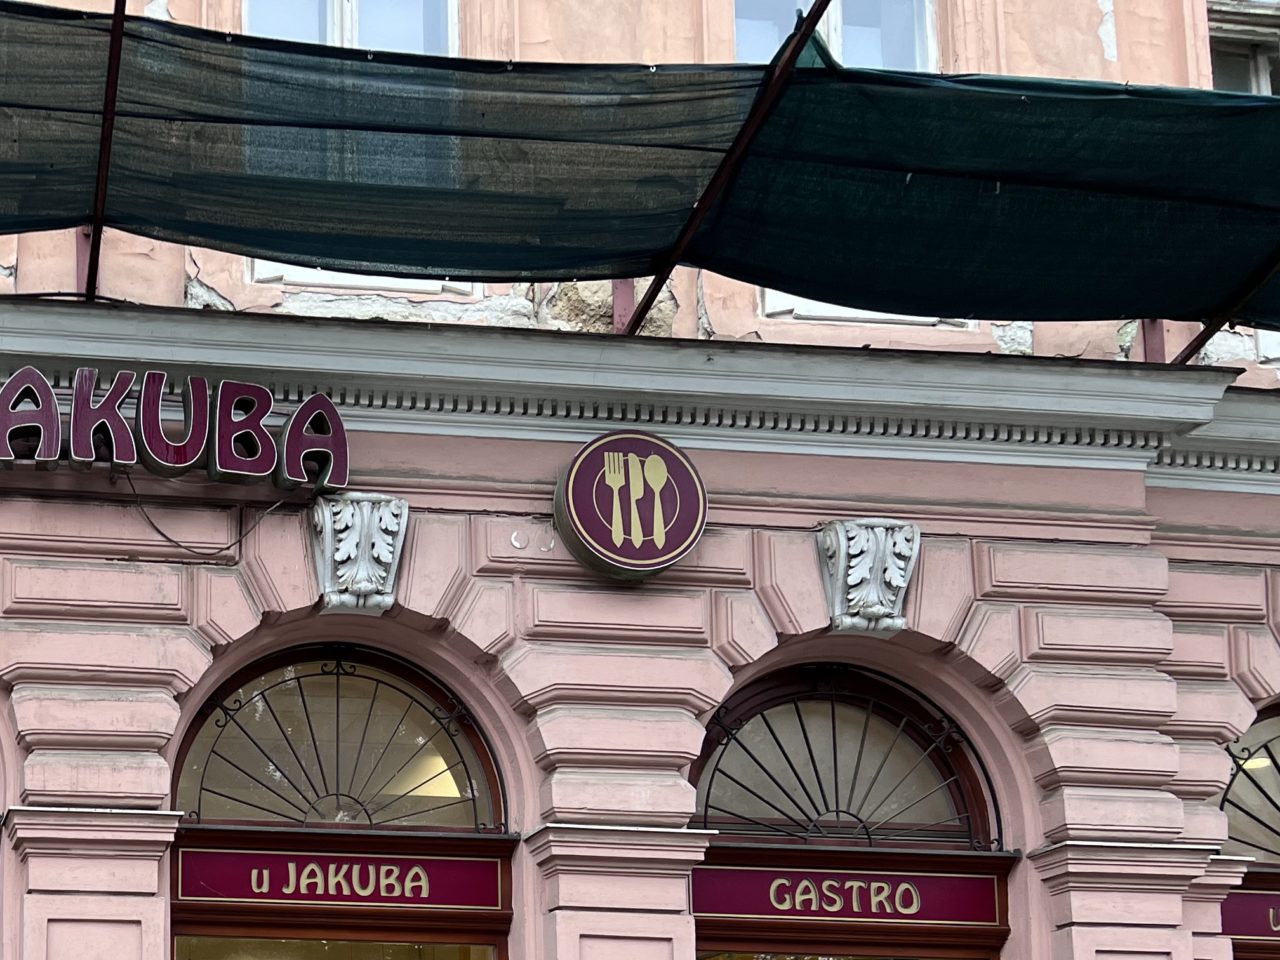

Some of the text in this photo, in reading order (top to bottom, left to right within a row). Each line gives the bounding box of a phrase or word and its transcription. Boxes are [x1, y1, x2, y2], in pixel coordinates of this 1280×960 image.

[250, 861, 430, 898] u JAKUBA
[770, 877, 921, 915] GASTRO
